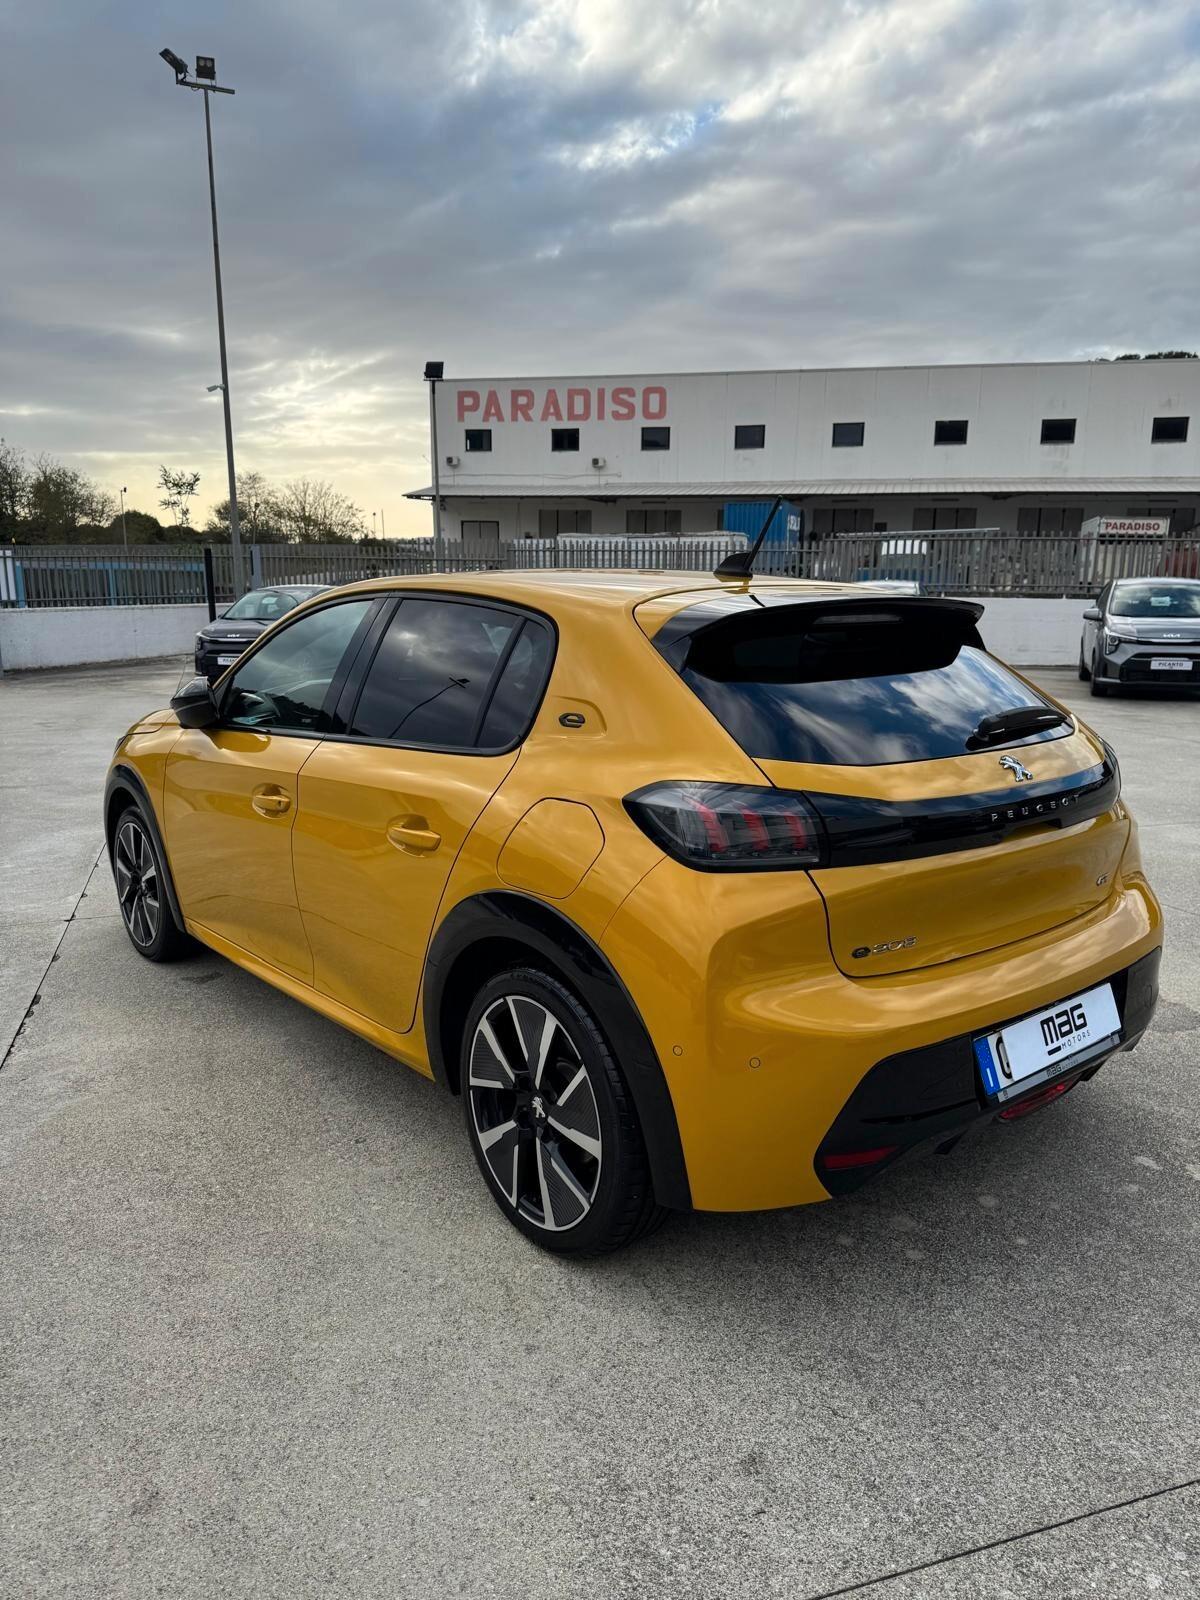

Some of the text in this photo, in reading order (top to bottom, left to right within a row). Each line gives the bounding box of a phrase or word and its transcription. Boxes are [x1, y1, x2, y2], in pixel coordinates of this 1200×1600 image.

[456, 386, 667, 423] PARADISO
[1105, 522, 1161, 531] PARADISO
[991, 794, 1080, 822] PEUGEOT
[1061, 1029, 1092, 1051] MOTORS
